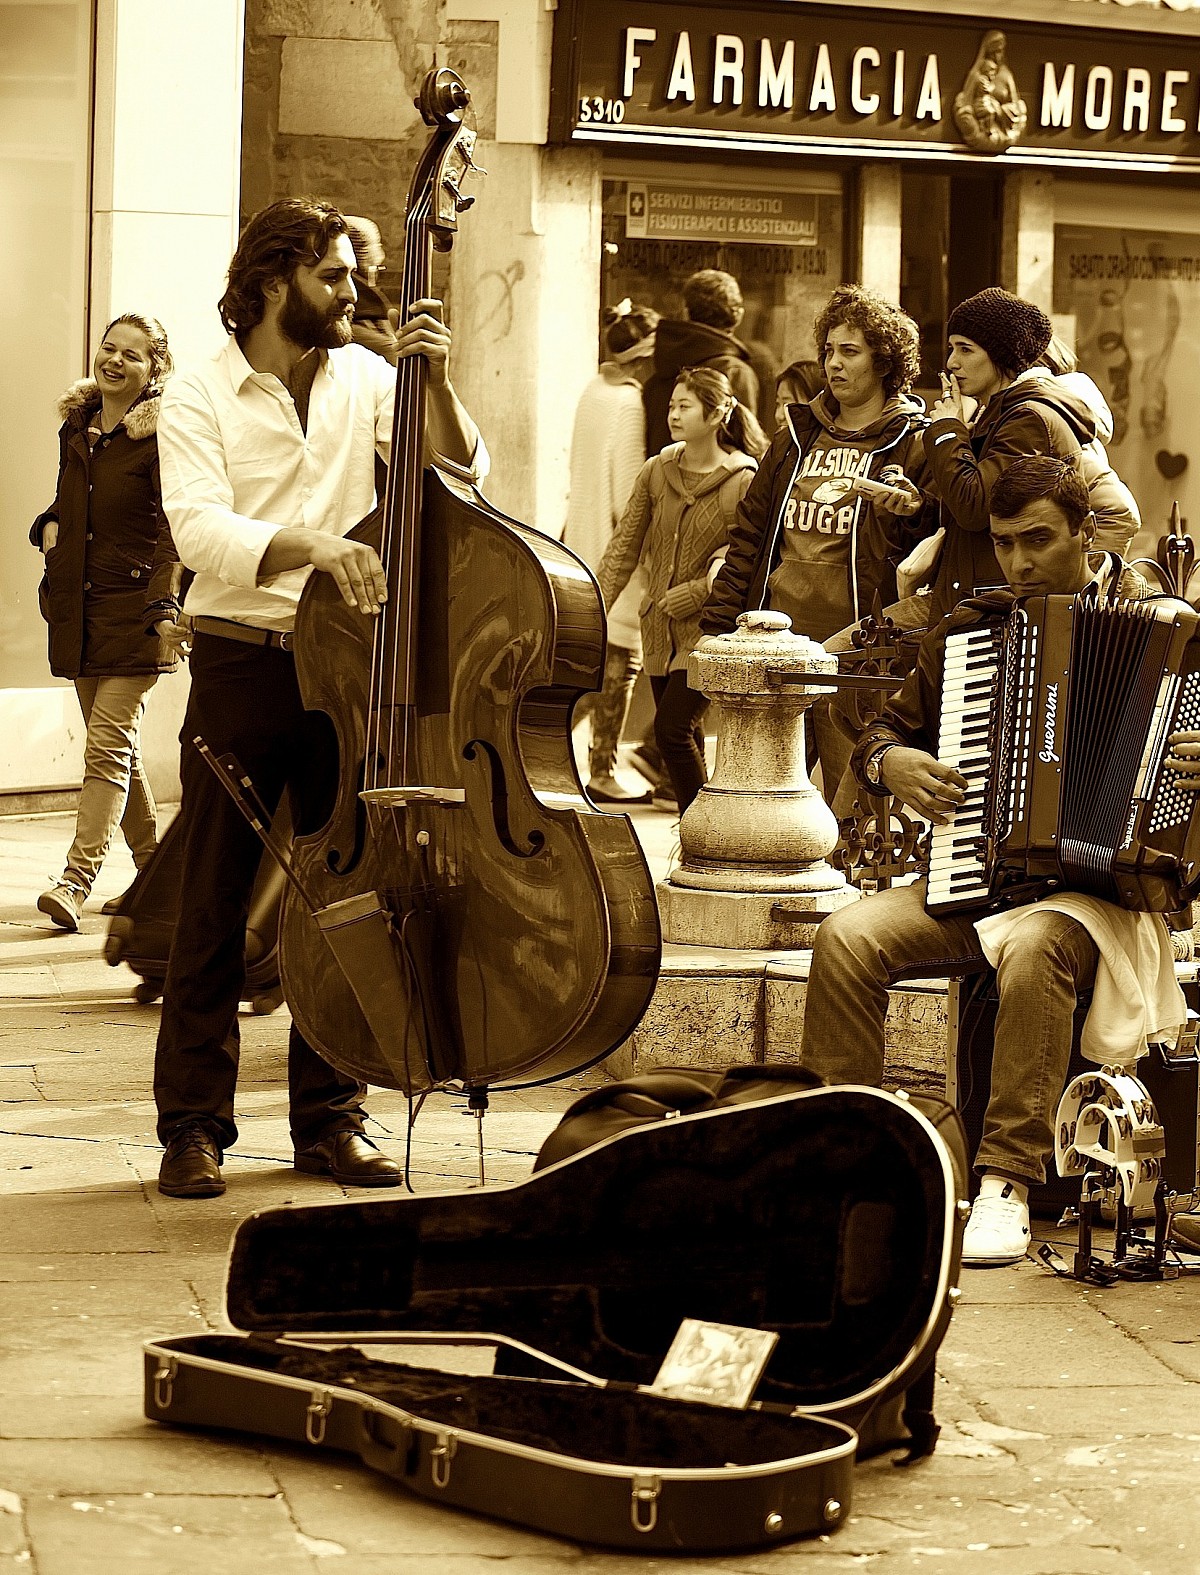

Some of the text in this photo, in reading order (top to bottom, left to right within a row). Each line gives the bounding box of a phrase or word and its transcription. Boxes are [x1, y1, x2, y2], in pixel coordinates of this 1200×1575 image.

[623, 26, 942, 121] FARMACIA
[580, 95, 625, 123] 5310
[650, 192, 693, 210] SERVIZI
[649, 214, 727, 232] FISIOTERAPICI
[728, 217, 736, 233] E
[737, 217, 814, 235] ASSISTENZIALI
[1038, 682, 1060, 763] Guerrini
